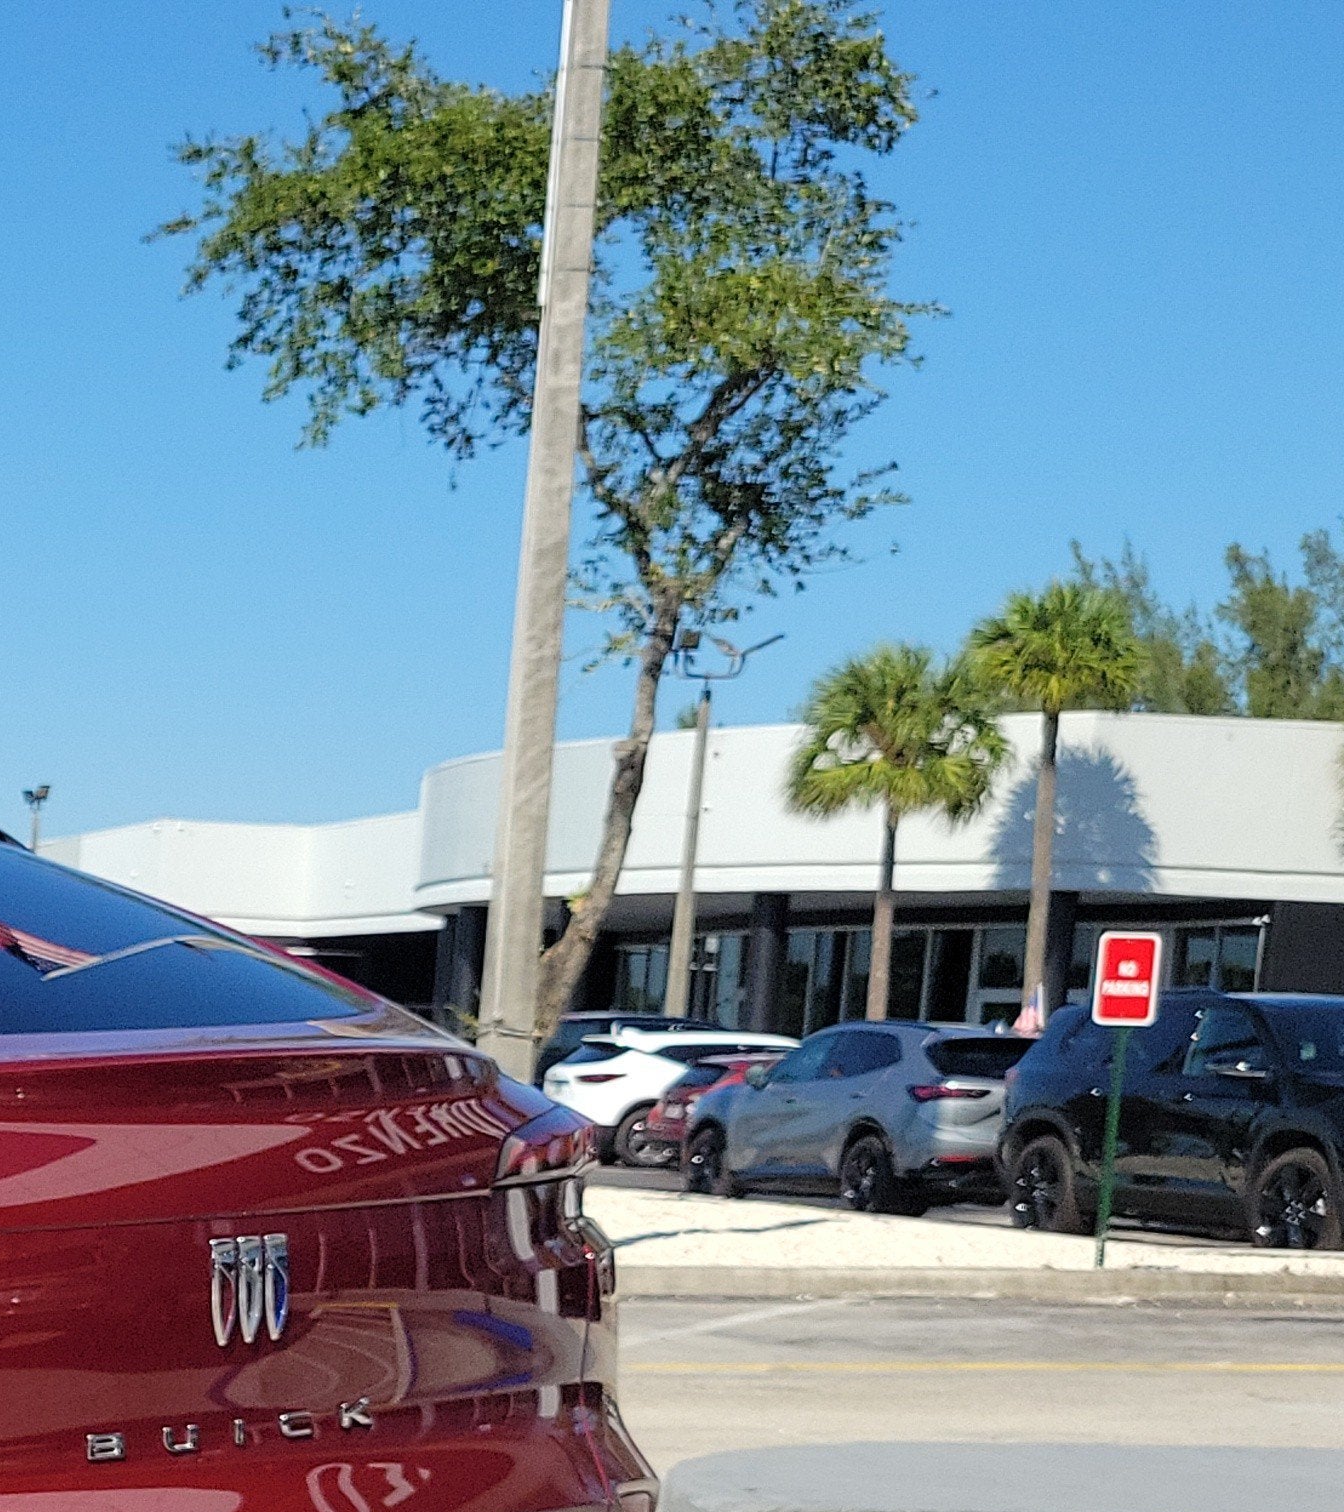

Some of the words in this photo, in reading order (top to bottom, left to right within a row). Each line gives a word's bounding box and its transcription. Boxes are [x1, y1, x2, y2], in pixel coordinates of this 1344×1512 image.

[1117, 959, 1140, 978] NO
[1101, 980, 1150, 998] PARKING
[86, 1397, 374, 1461] BUICK
